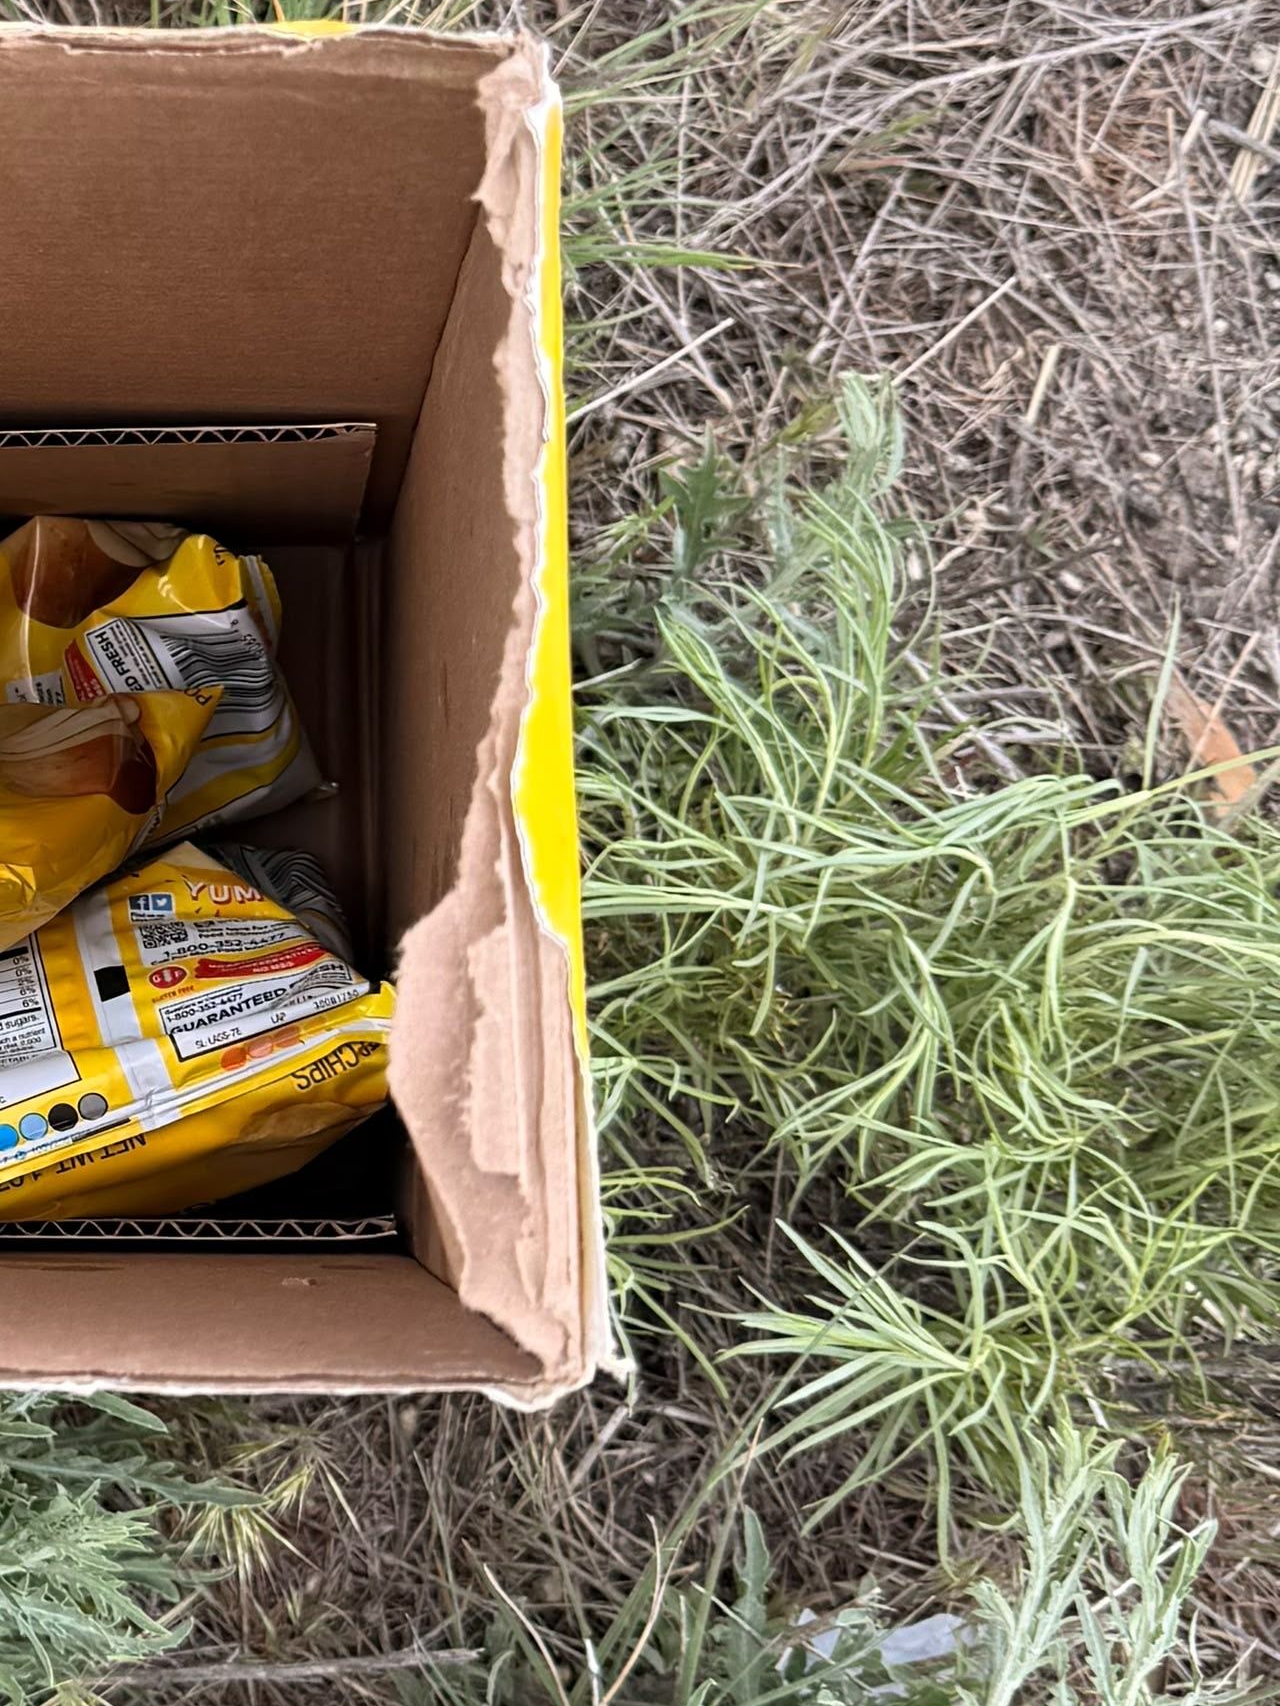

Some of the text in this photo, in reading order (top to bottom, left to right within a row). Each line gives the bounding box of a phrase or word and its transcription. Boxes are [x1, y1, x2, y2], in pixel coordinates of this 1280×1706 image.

[94, 631, 130, 675] FRESH
[189, 878, 267, 906] YUM
[21, 997, 39, 1008] 6%
[168, 984, 289, 1038] GUARANTEED
[4, 1013, 40, 1029] sugars.
[285, 1040, 362, 1092] CHIPS
